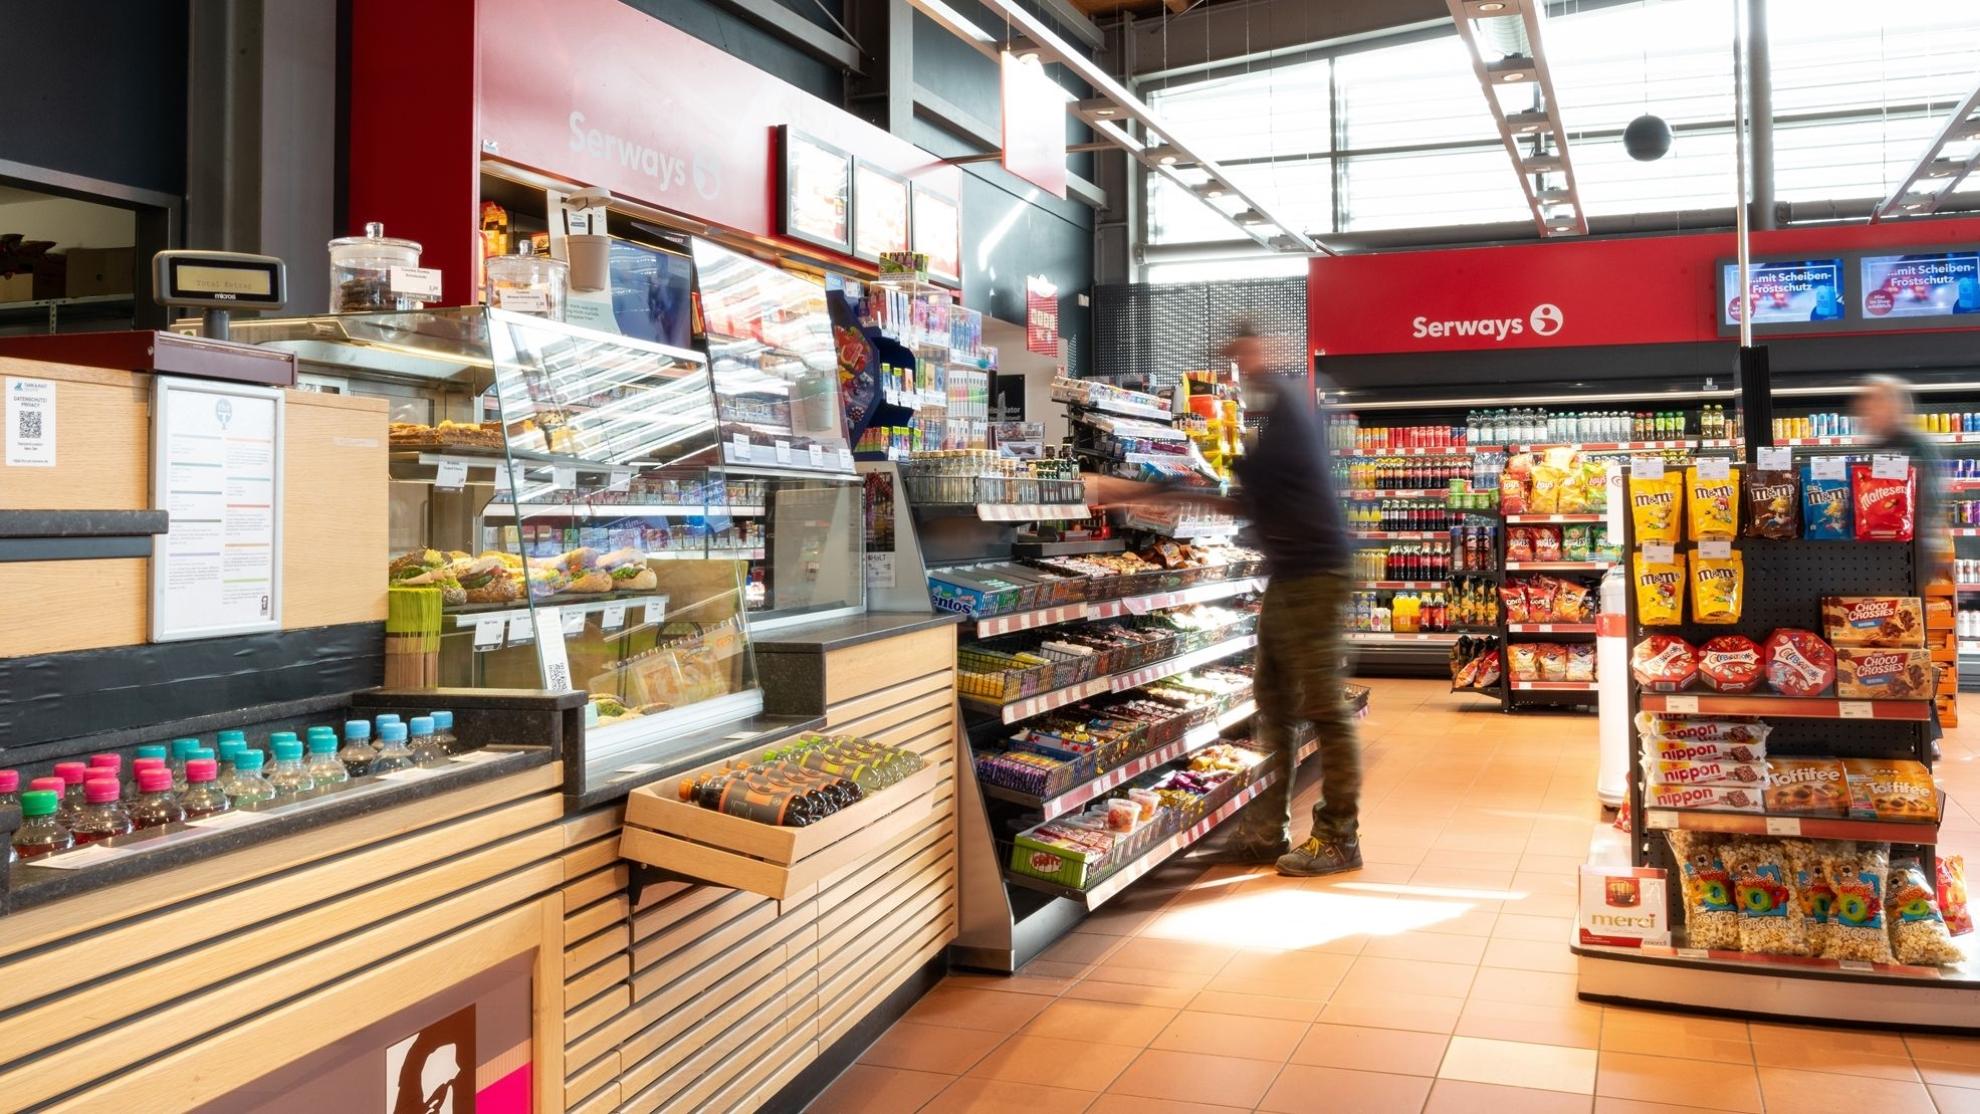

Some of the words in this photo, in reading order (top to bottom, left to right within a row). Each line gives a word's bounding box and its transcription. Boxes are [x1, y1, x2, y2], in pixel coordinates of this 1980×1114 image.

[568, 111, 686, 192] Serways
[1778, 271, 1832, 282] Scheiben-
[1918, 264, 1975, 275] Scheiben-
[1752, 283, 1813, 294] Frostschutz
[1891, 275, 1955, 287] Frostschutz
[1412, 316, 1524, 342] Serways
[933, 594, 972, 615] entos
[1855, 602, 1888, 613] CHOCO
[1848, 608, 1894, 621] CROSSIES
[1864, 655, 1898, 667] CHOCO
[1856, 662, 1904, 677] CROSSIES
[1662, 744, 1718, 760] nippon
[1664, 763, 1721, 783] nippon
[1770, 767, 1841, 787] Toffifee
[1868, 781, 1931, 797] Toffifee
[1657, 787, 1713, 807] nippon
[1591, 913, 1656, 928] merci
[1696, 912, 1734, 922] POPCO
